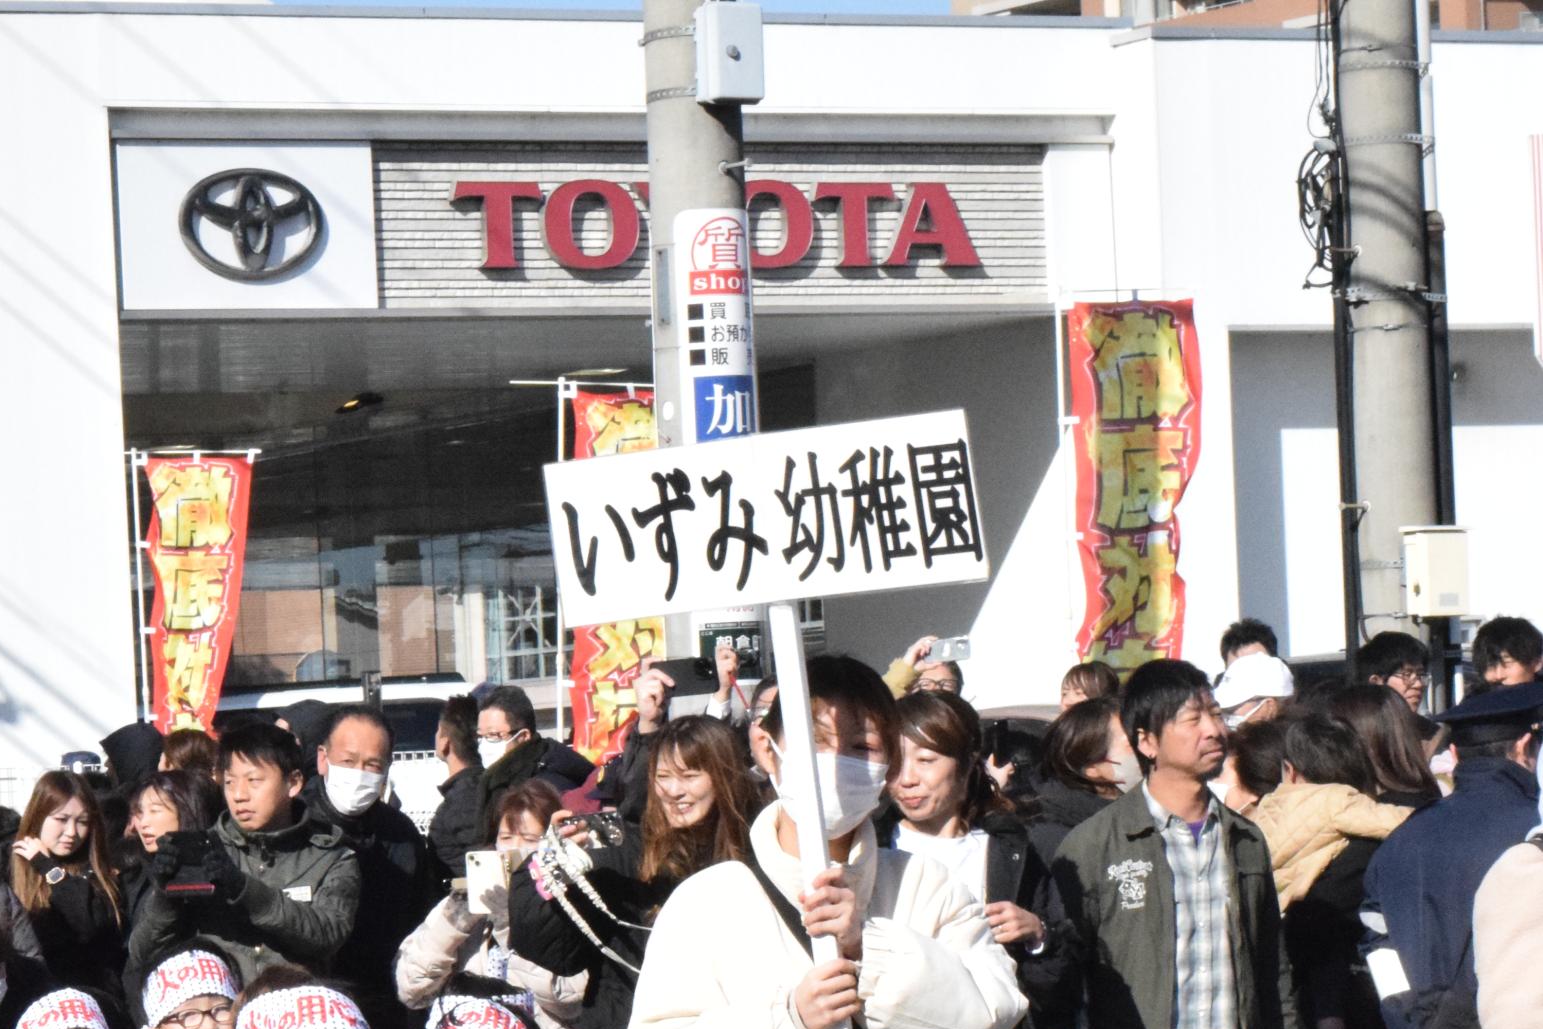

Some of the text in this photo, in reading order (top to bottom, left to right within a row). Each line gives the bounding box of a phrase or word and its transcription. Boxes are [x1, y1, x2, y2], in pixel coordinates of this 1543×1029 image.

[452, 178, 982, 271] TOOTA
[693, 272, 744, 292] sho
[562, 439, 983, 601] いずみ幼稚園
[1086, 311, 1191, 666] 徹底対
[152, 463, 233, 731] 徹底対
[157, 958, 238, 1003] 火の用
